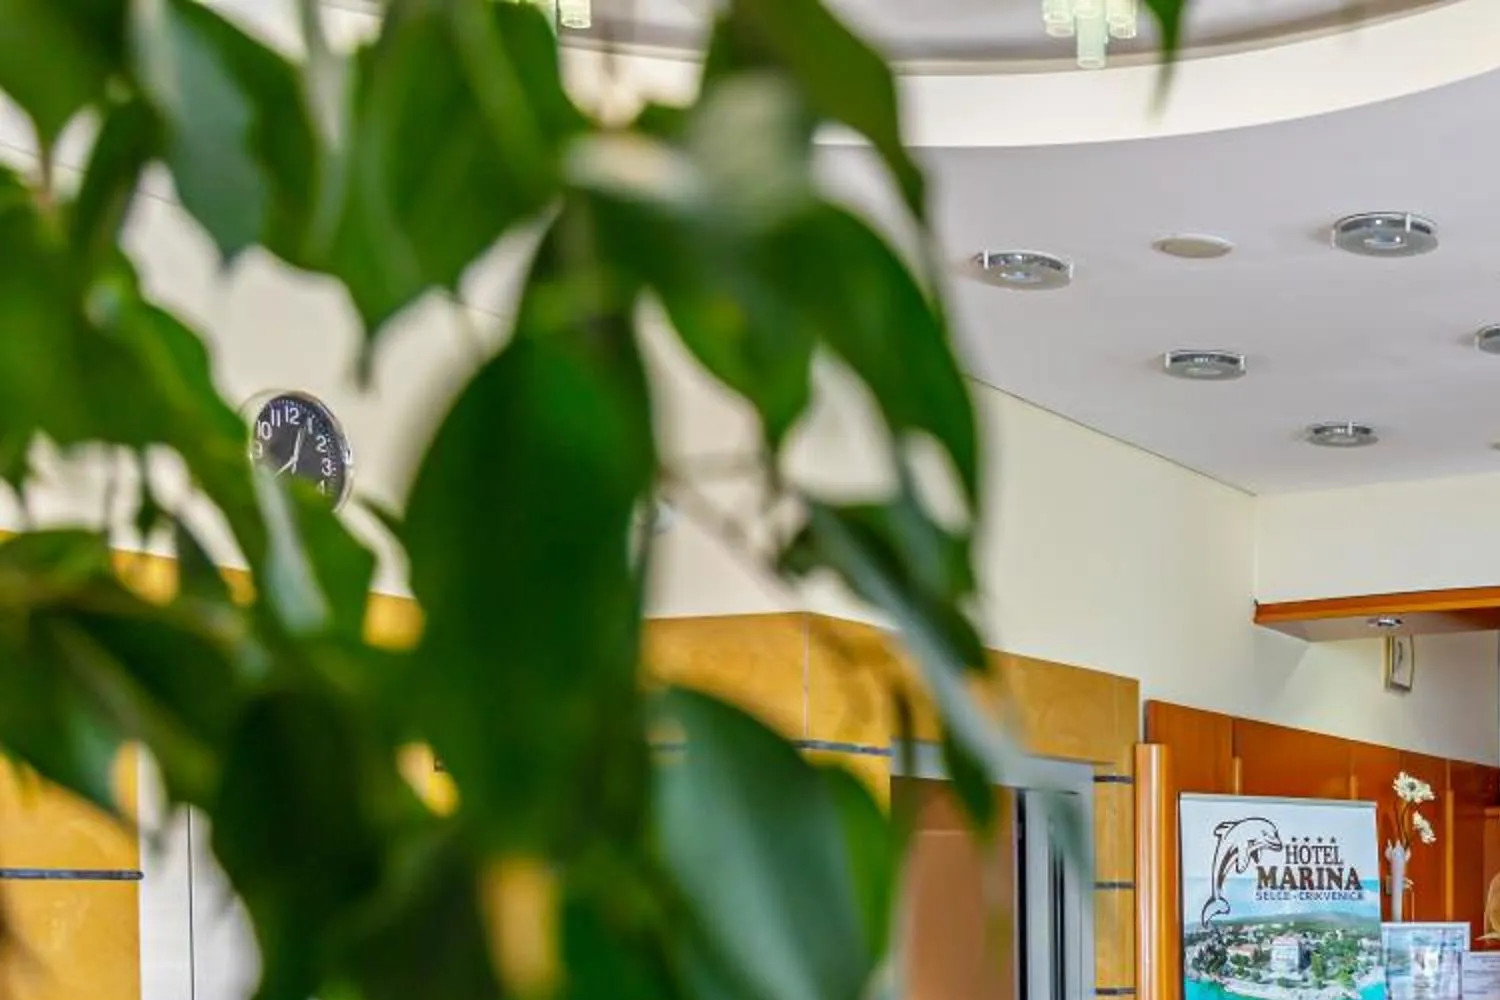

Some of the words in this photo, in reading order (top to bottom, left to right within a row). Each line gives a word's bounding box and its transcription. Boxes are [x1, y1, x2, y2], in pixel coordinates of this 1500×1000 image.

[257, 420, 272, 440] 10
[306, 414, 314, 435] 1
[271, 409, 281, 428] 11
[285, 405, 301, 425] 12
[316, 435, 327, 453] 2
[322, 458, 332, 477] 3
[1285, 844, 1344, 865] HOTEL
[1256, 865, 1363, 890] MARINA
